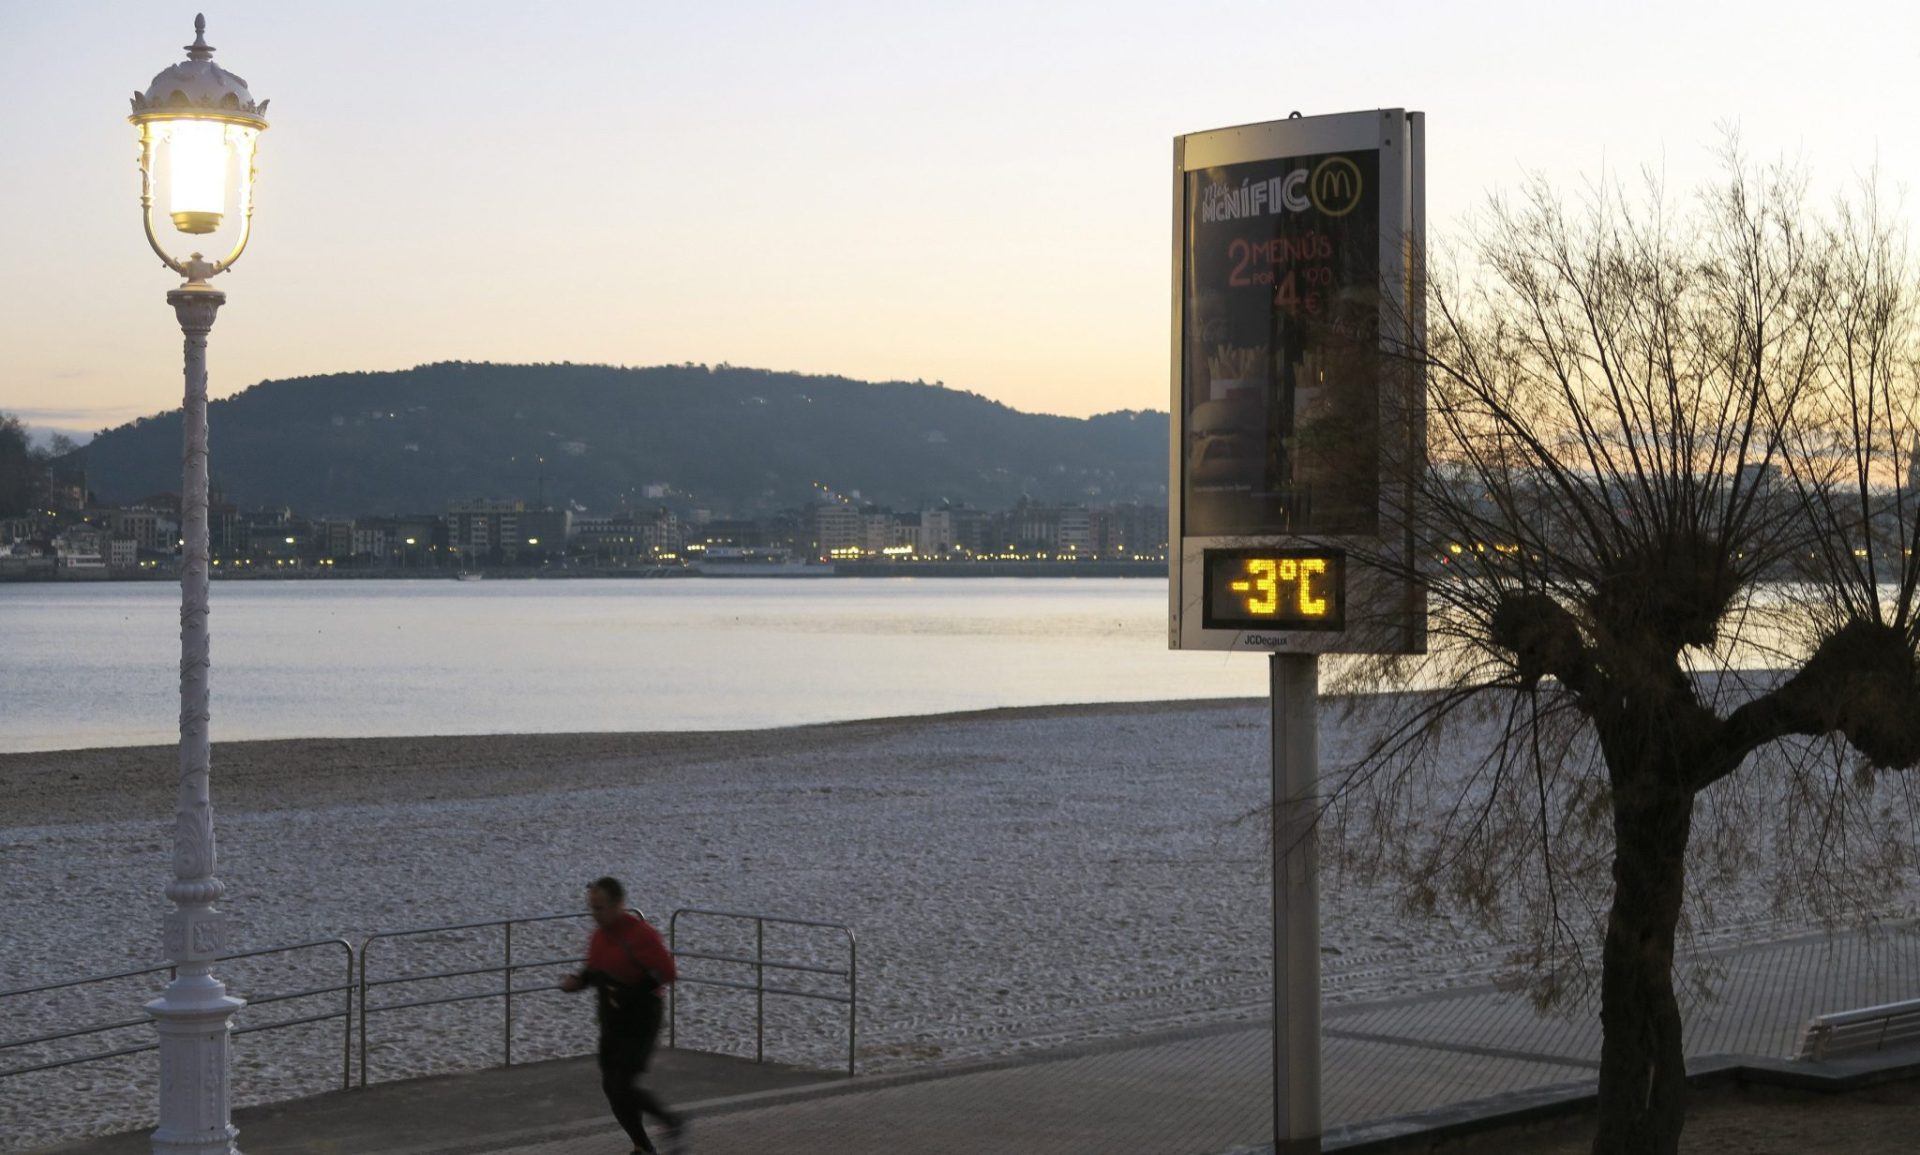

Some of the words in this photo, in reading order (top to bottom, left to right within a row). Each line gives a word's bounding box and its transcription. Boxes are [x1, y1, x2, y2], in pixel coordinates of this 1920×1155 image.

[1228, 239, 1251, 286] 2
[1252, 231, 1332, 263] MENÚS
[1252, 271, 1275, 285] POR
[1244, 633, 1288, 646] JCDecaux
